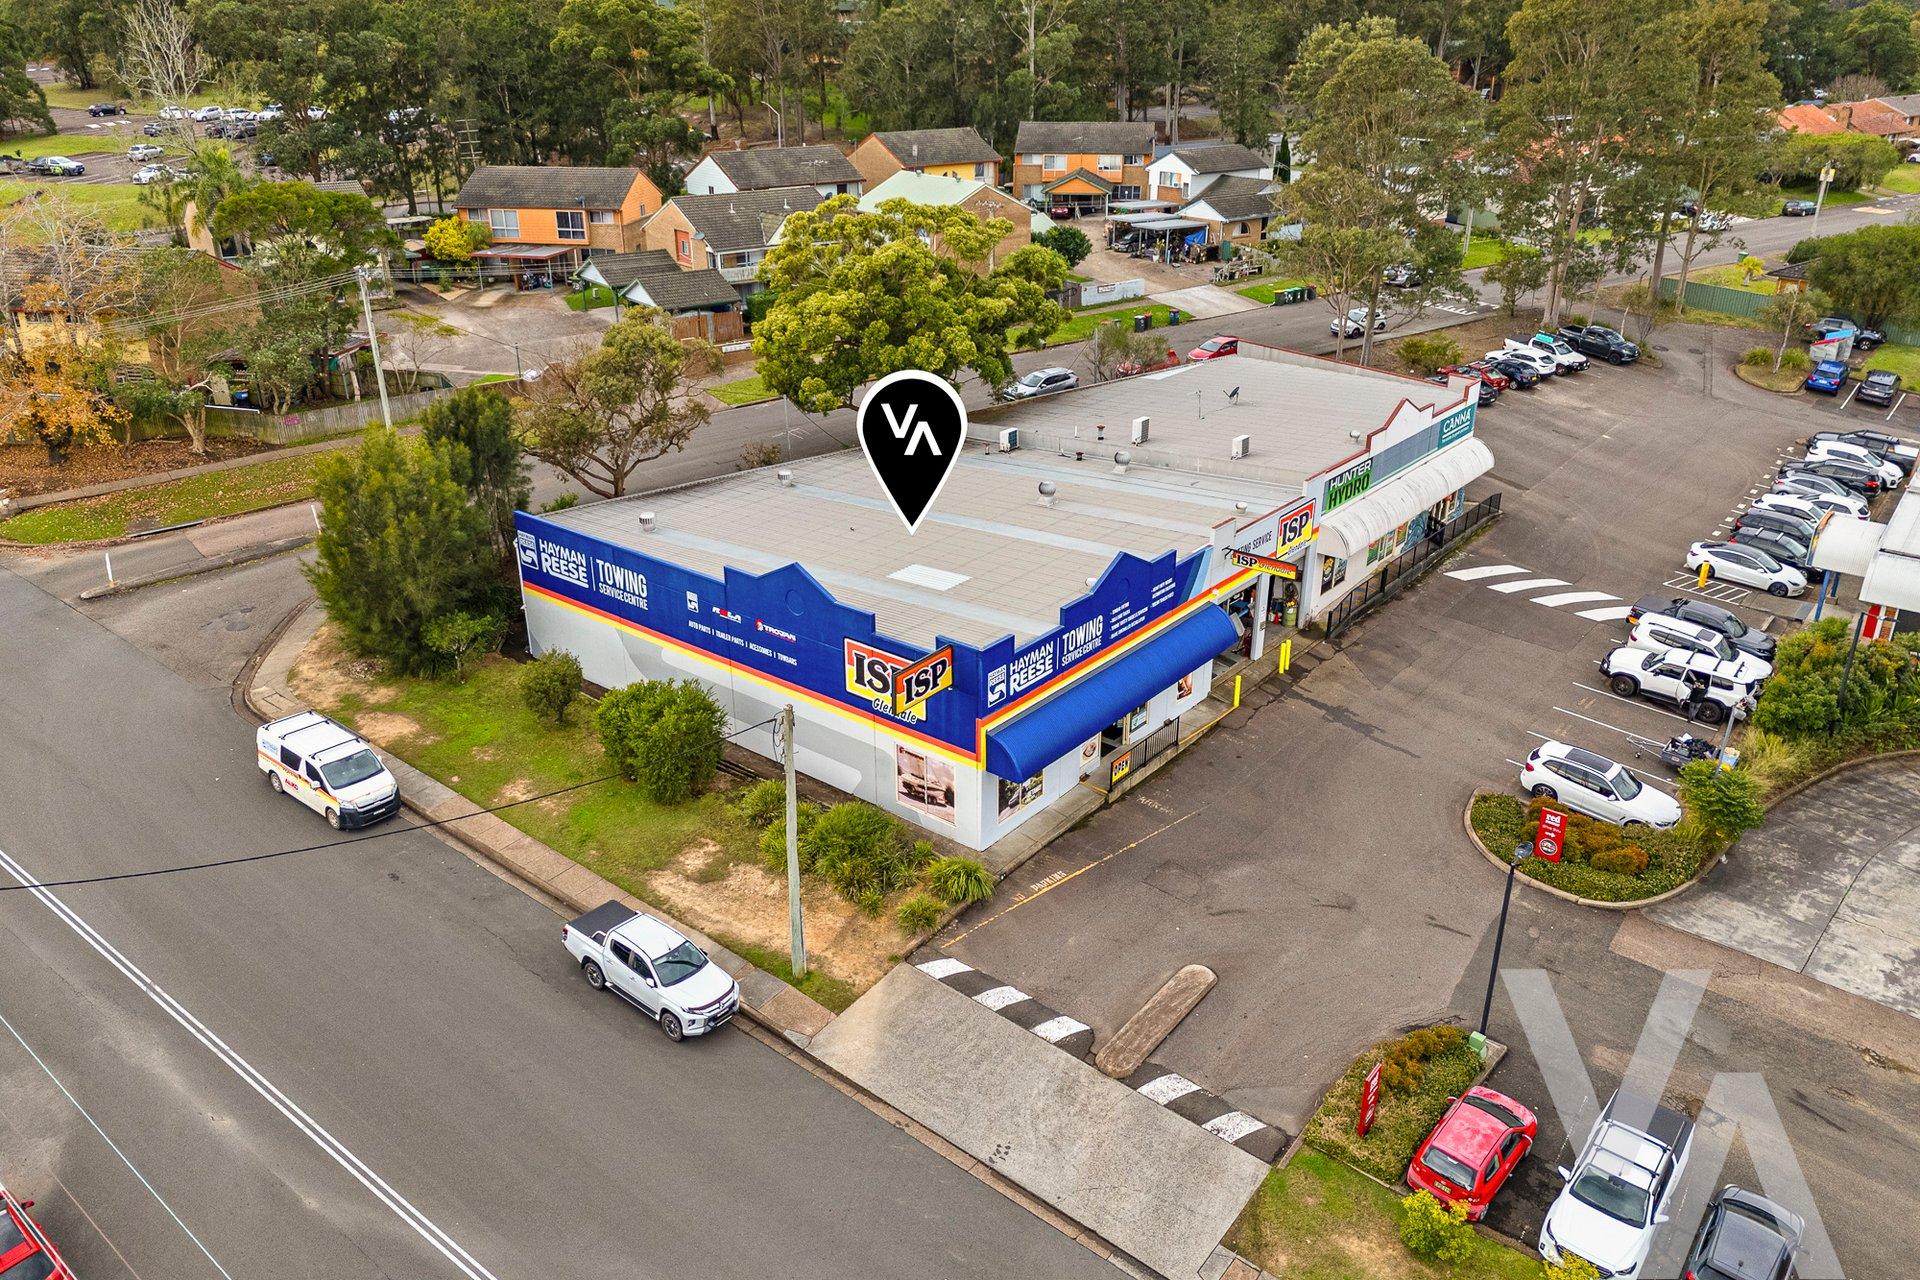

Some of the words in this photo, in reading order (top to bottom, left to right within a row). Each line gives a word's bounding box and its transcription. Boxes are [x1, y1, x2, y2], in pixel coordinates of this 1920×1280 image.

[1443, 408, 1471, 433] CANNA
[1328, 474, 1370, 510] HYDRO
[1330, 459, 1372, 490] HUNTER
[1281, 511, 1310, 547] ISP
[539, 538, 587, 567] HAYMAN
[540, 552, 588, 583] REESE
[1236, 554, 1258, 567] ISP
[596, 558, 648, 598] TOWING
[1062, 615, 1103, 655] TOWING
[853, 650, 899, 697] IS
[1009, 653, 1054, 696] REESE
[1010, 640, 1054, 676] HAYMAN
[905, 658, 947, 705] ISP
[872, 698, 918, 725] Glenale
[1030, 870, 1067, 892] PARKING
